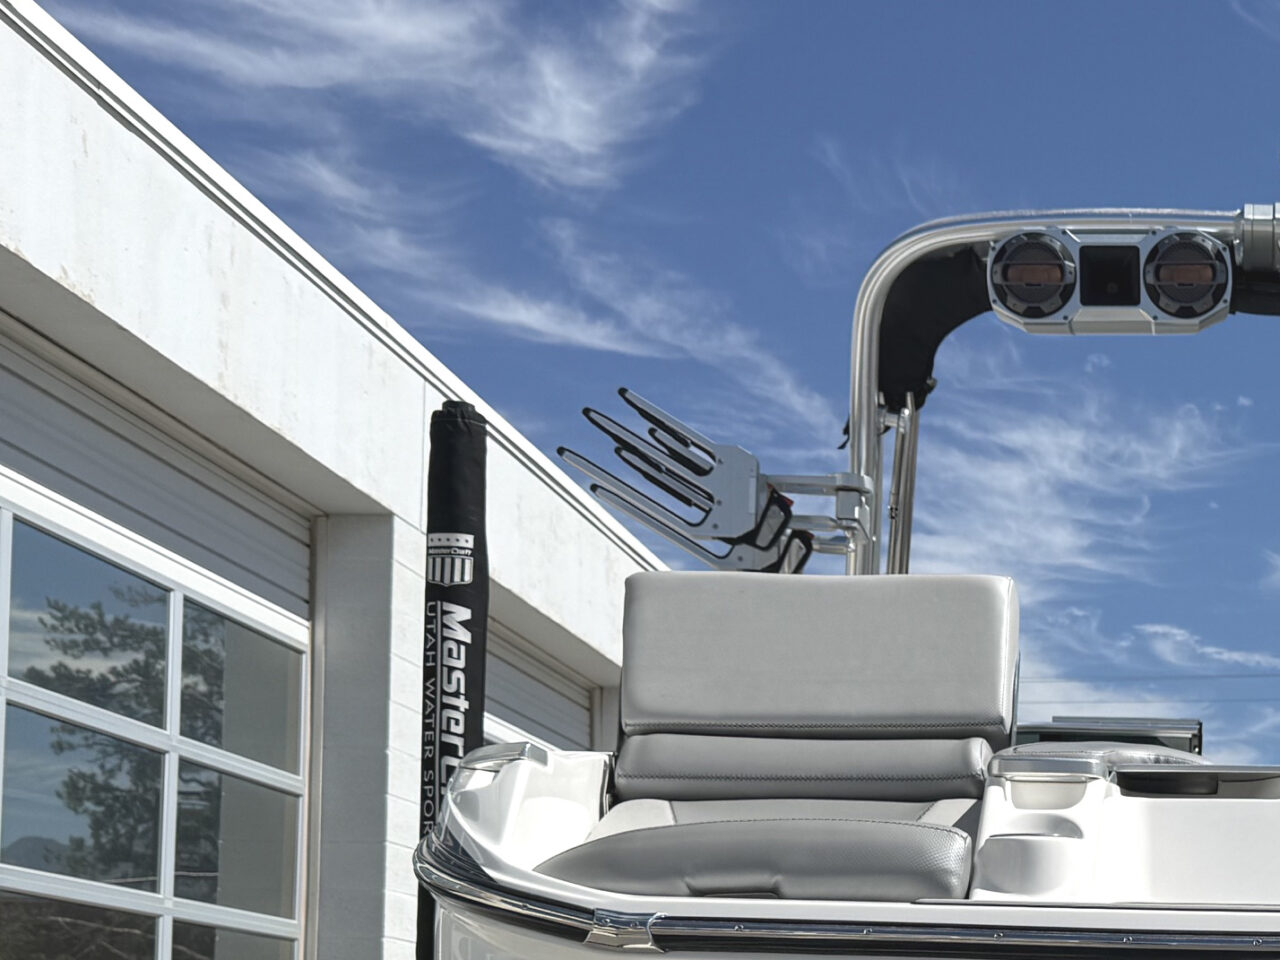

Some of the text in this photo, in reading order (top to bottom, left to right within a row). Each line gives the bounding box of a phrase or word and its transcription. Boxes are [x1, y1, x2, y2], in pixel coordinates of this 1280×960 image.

[423, 601, 437, 835] UTAH WATER SPOR
[440, 601, 473, 795] MasterC
